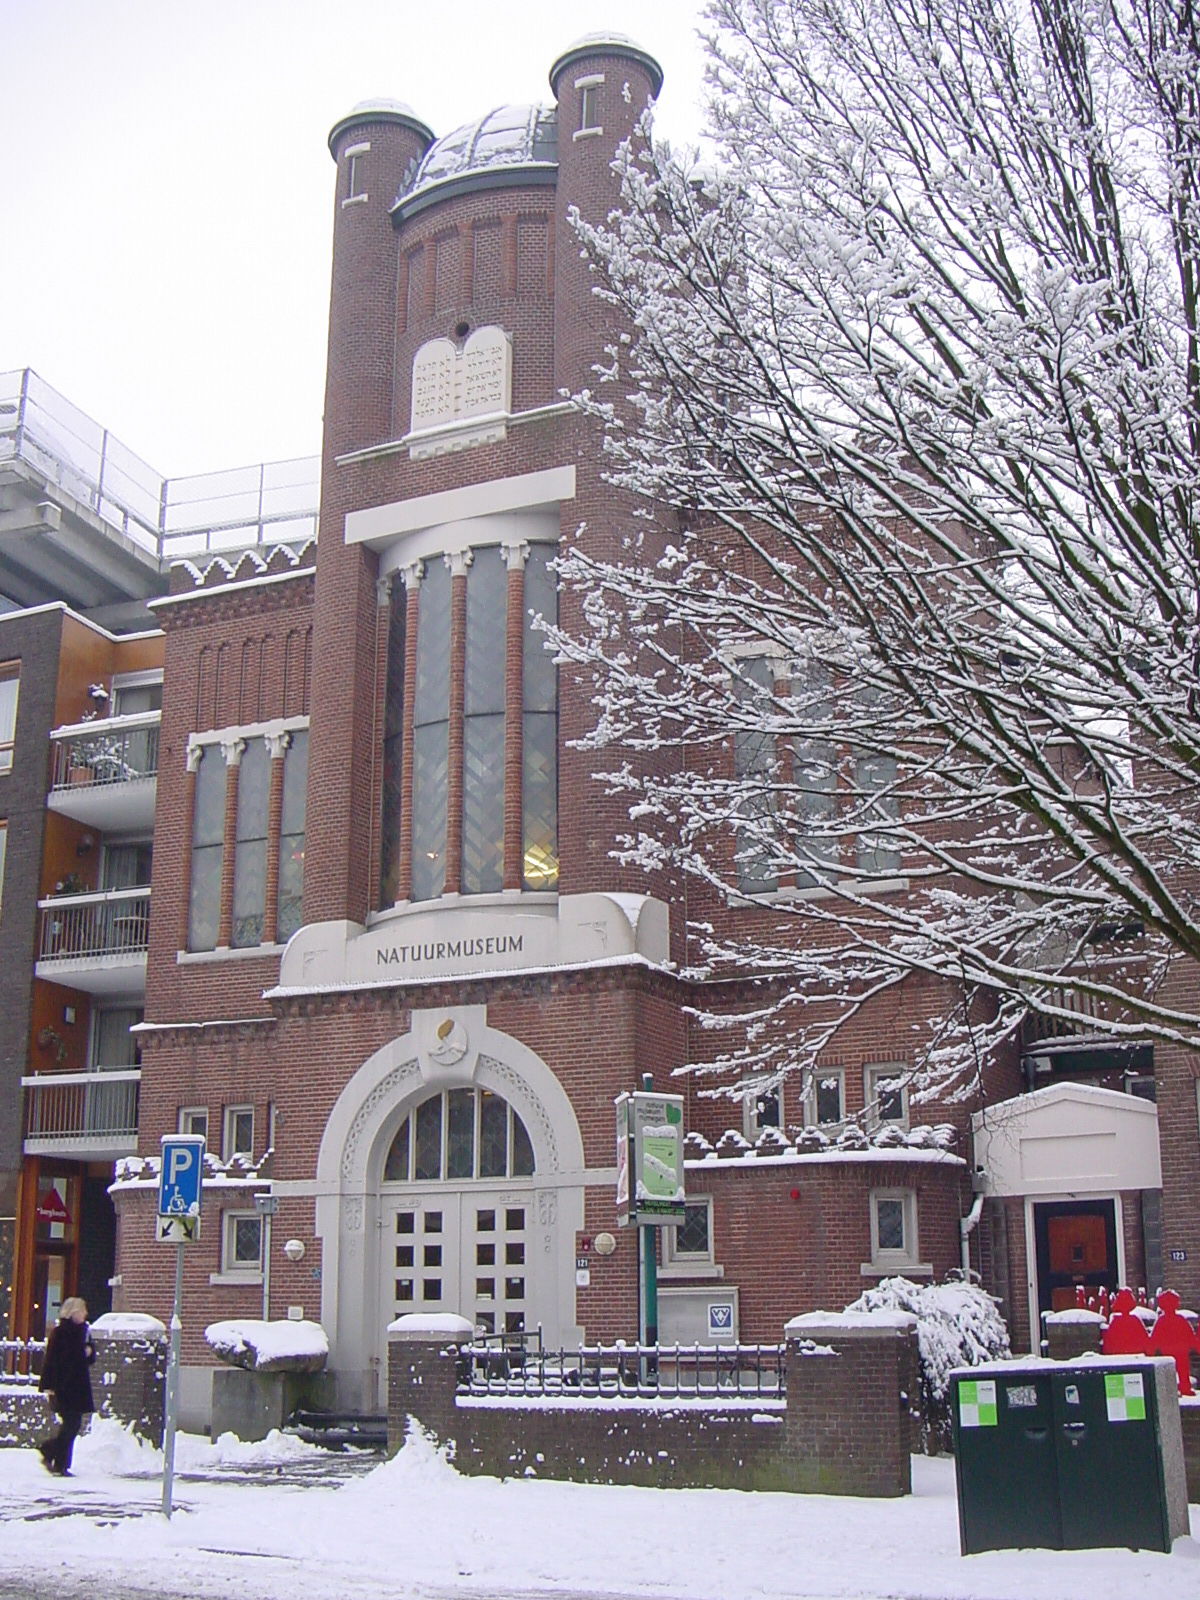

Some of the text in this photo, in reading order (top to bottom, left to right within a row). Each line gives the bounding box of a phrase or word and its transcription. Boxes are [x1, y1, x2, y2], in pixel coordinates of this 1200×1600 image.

[376, 935, 523, 965] NATUURMUSEUM
[169, 1148, 193, 1185] P
[577, 1259, 588, 1268] 121
[1172, 1252, 1185, 1261] 123
